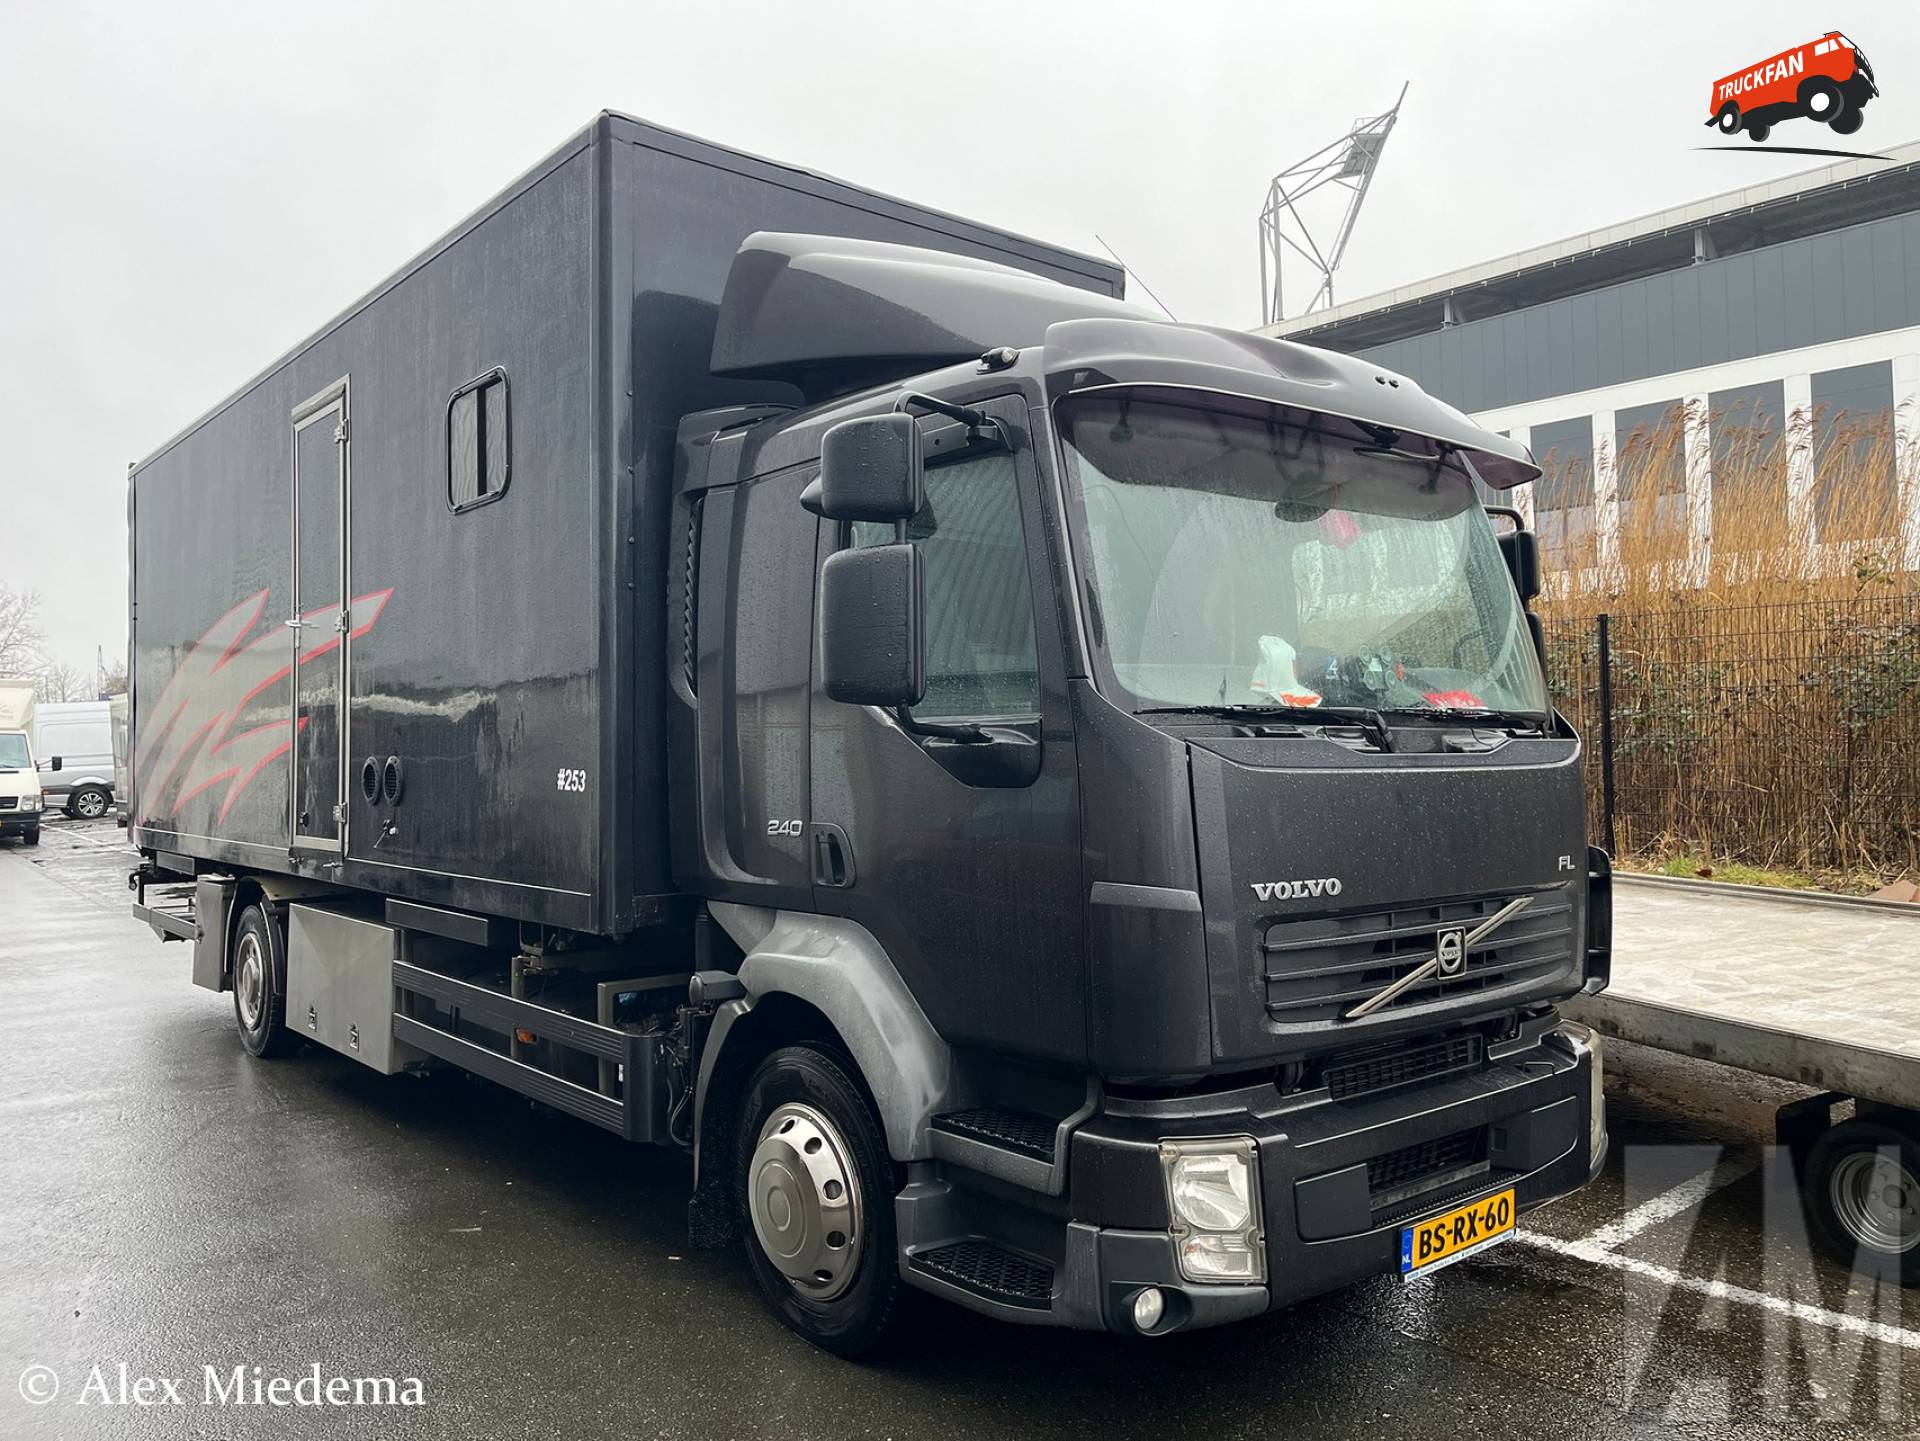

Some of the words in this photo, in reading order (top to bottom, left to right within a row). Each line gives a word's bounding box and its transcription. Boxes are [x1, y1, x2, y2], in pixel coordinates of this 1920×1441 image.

[557, 768, 586, 792] #253
[766, 819, 802, 836] 240
[1559, 855, 1575, 871] FL
[1251, 877, 1342, 901] VOLVO
[1419, 1197, 1509, 1260] BS-RX-60
[1402, 1253, 1411, 1265] NL
